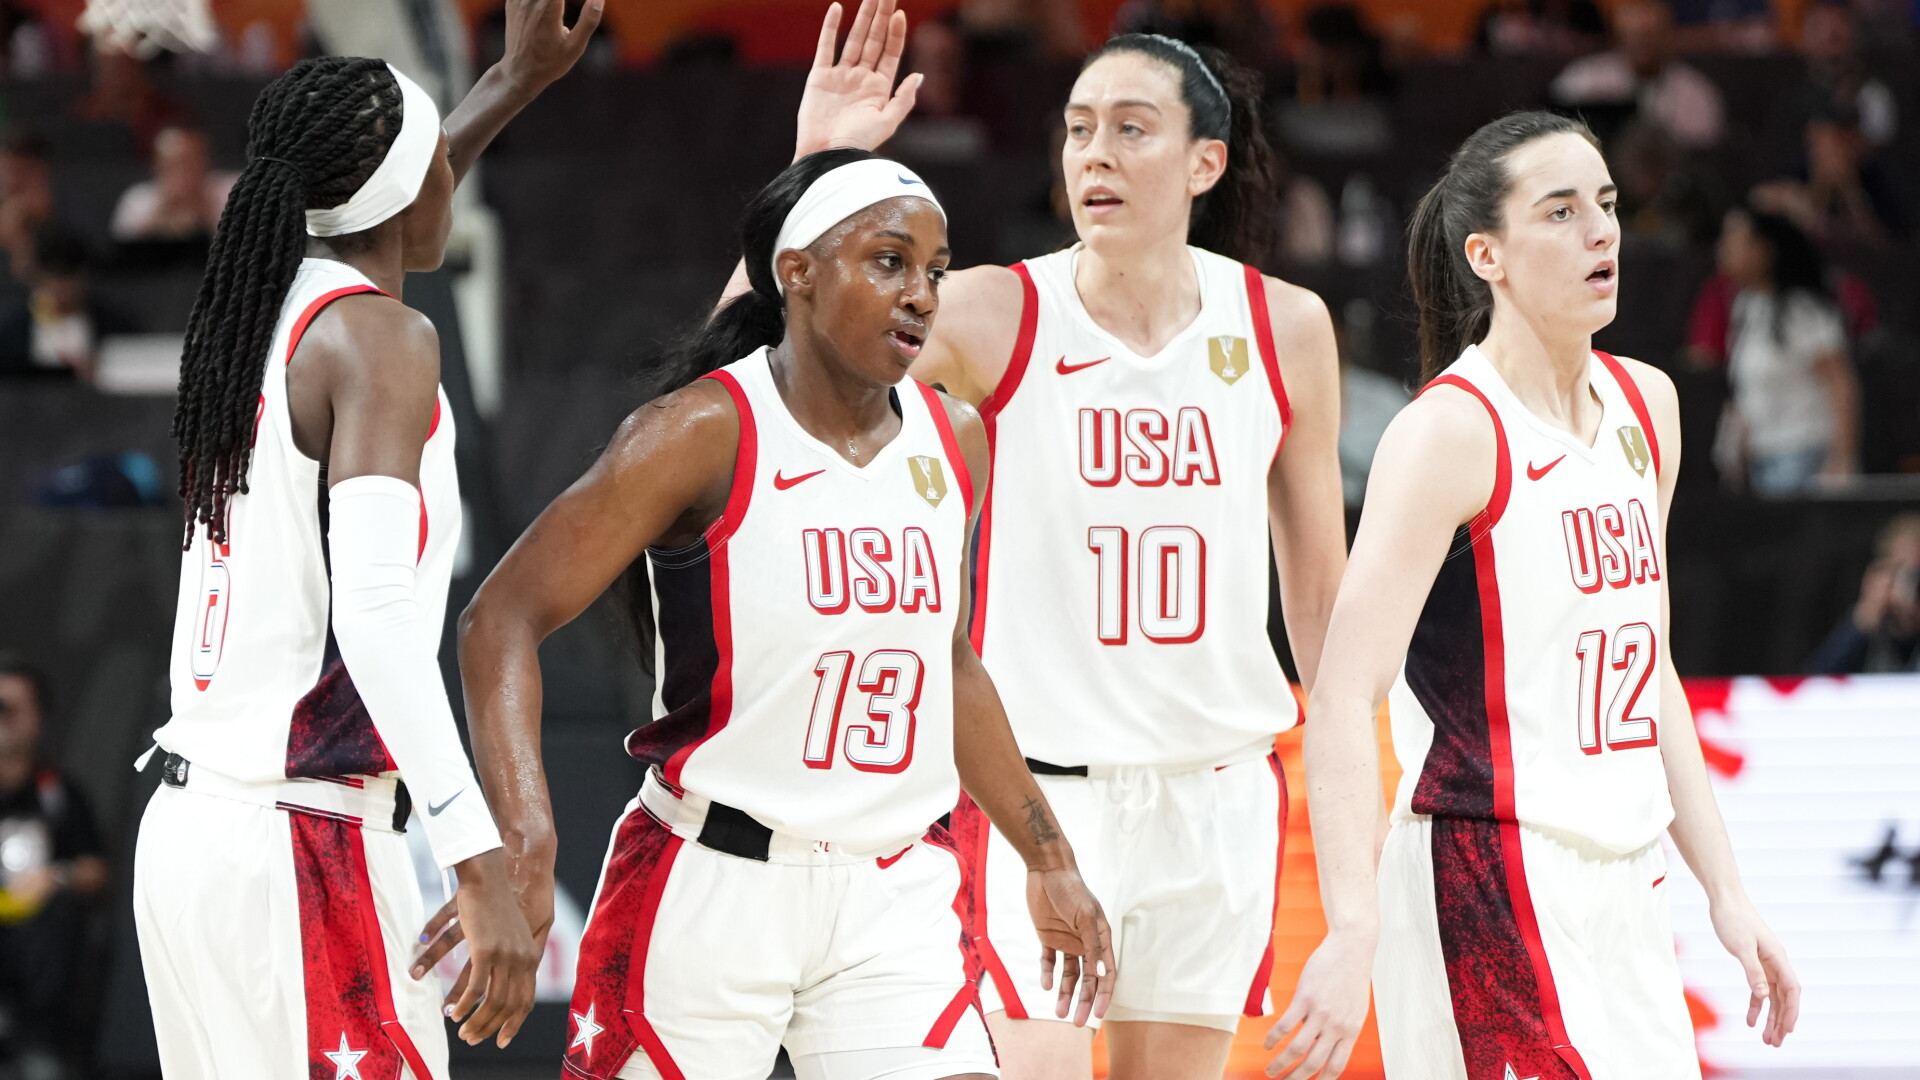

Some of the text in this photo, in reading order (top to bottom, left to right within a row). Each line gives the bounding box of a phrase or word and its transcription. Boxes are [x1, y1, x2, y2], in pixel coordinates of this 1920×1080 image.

[1079, 406, 1221, 487] USA
[191, 486, 231, 691] 6
[802, 526, 942, 615] USA
[1088, 525, 1206, 646] 10
[1561, 498, 1660, 594] USA
[802, 648, 925, 774] 13
[1575, 621, 1657, 755] 12
